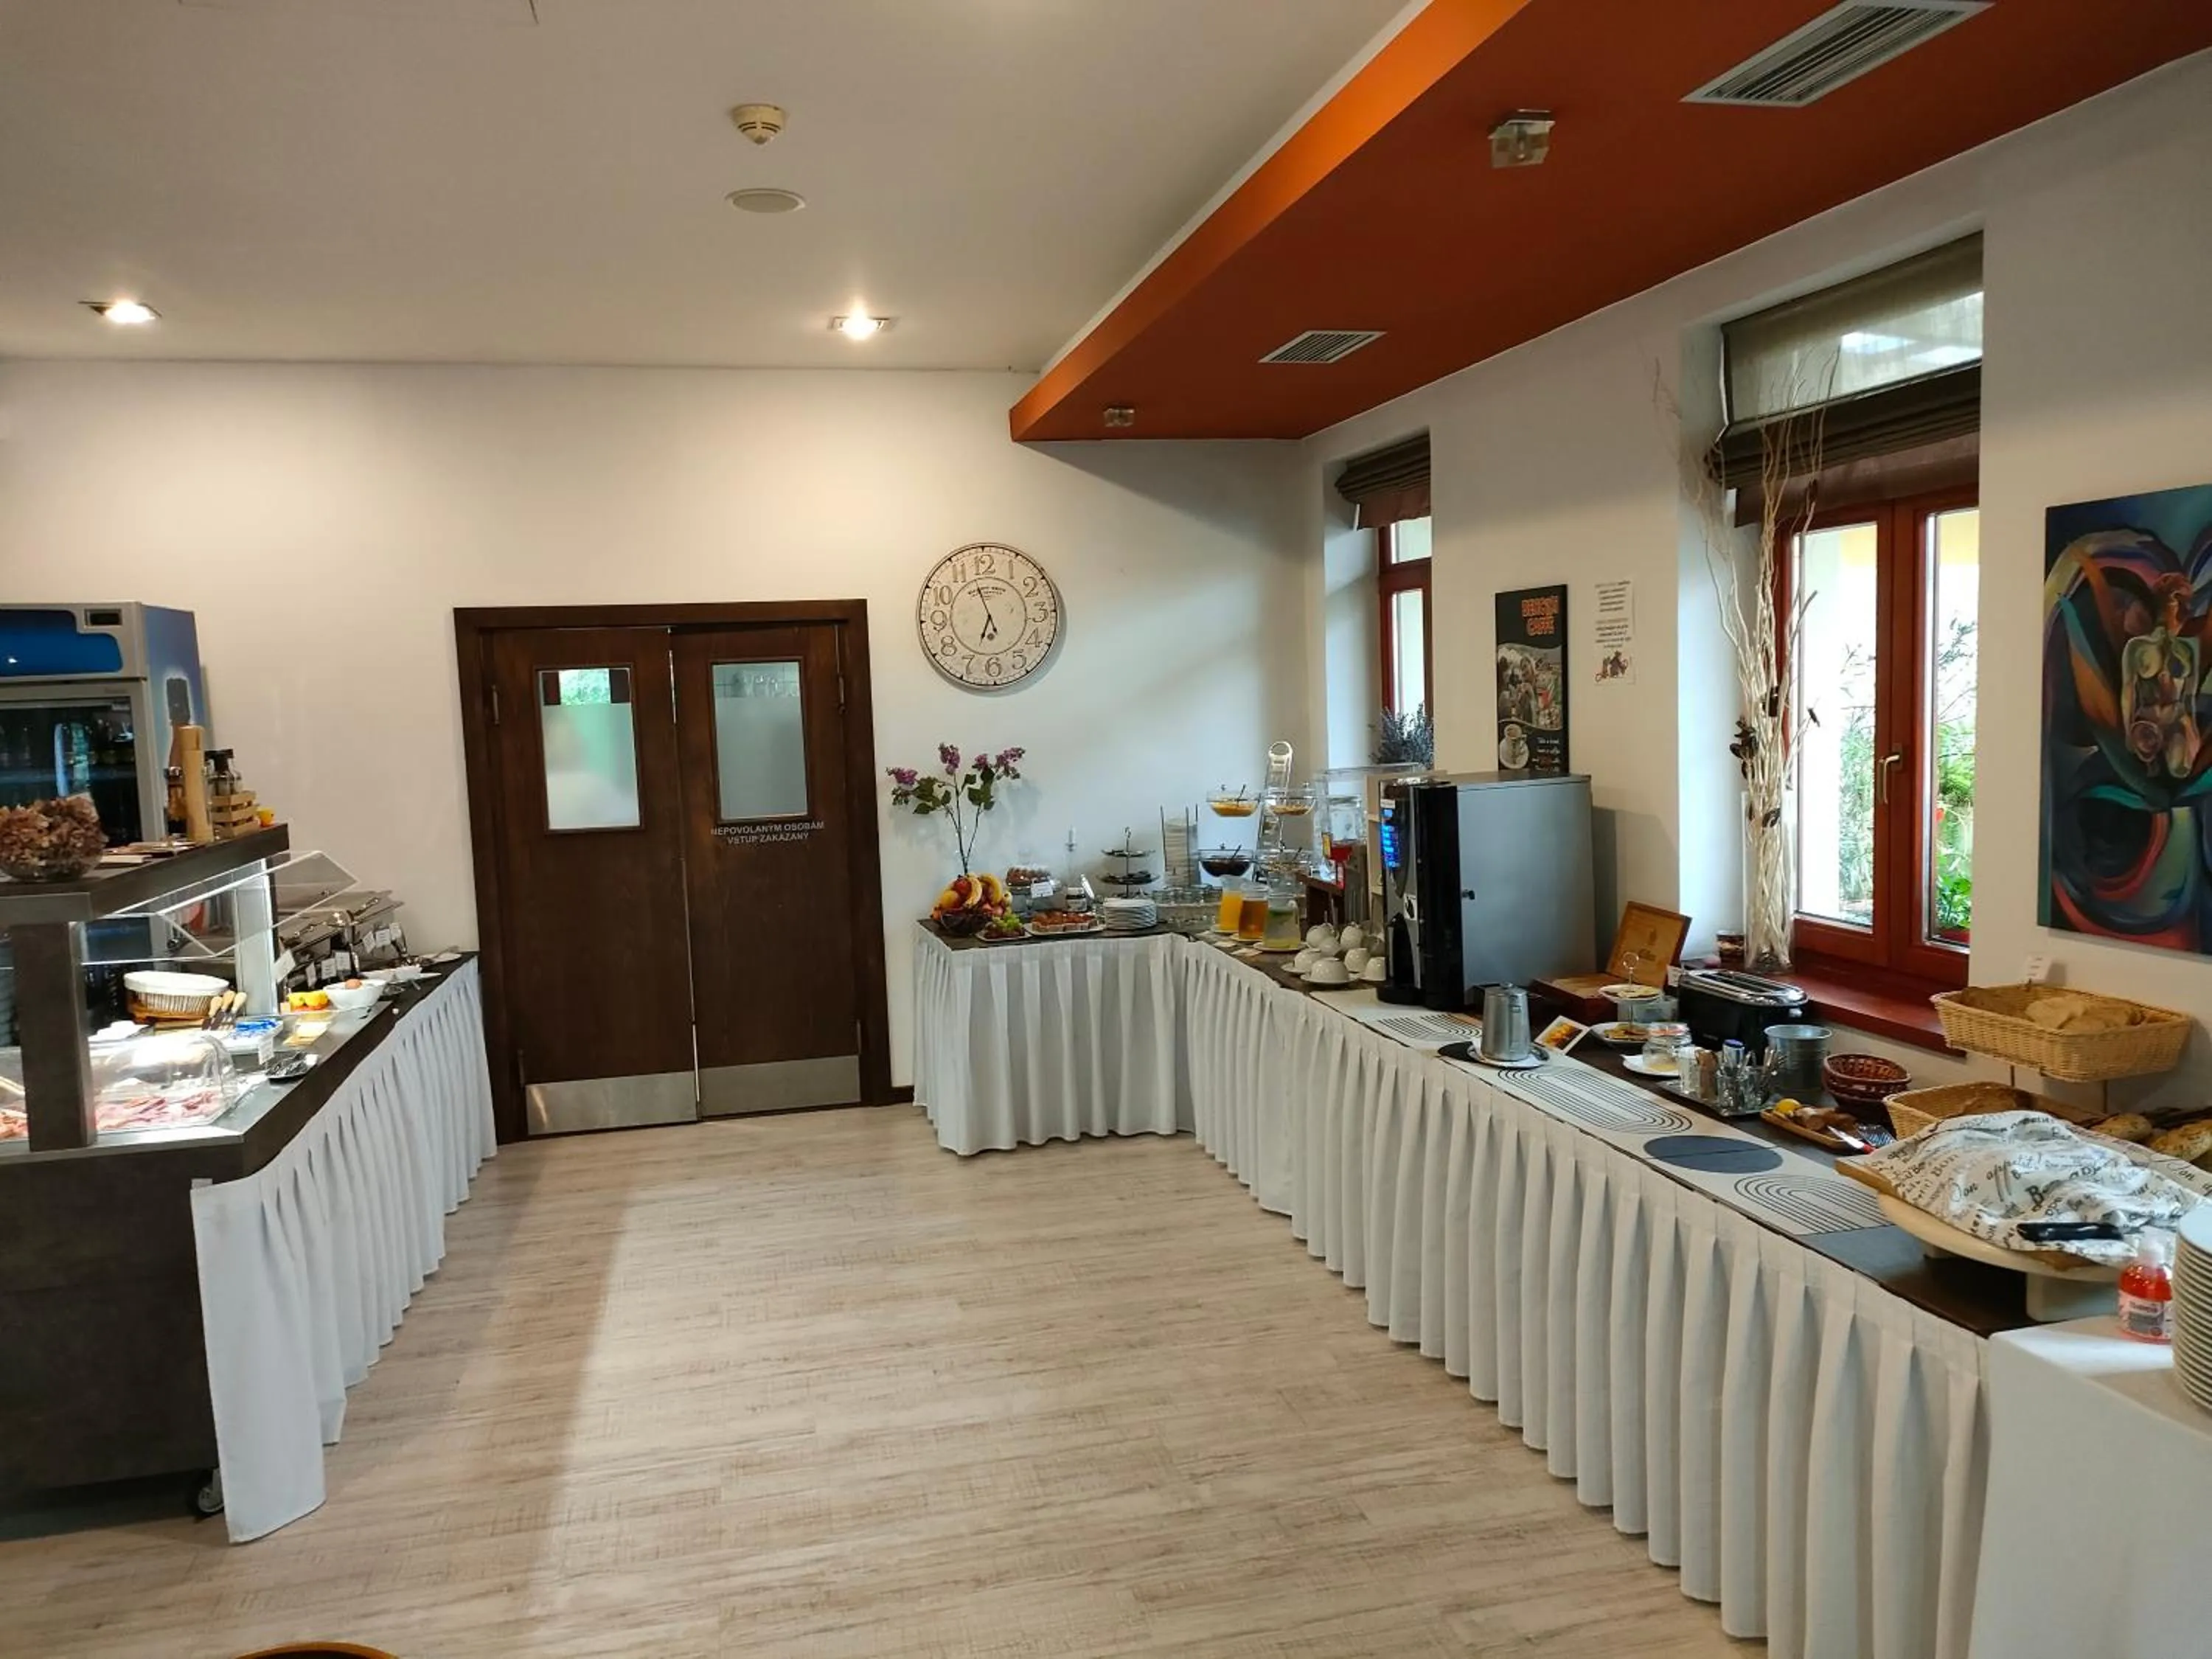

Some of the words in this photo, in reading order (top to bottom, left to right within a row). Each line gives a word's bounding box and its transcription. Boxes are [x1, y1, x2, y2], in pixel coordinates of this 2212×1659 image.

[952, 560, 967, 583] 11
[973, 554, 996, 576] 12
[1007, 559, 1015, 580] 1
[933, 585, 953, 606] 10
[1023, 576, 1039, 598] 2
[930, 610, 948, 632] 9
[1032, 601, 1049, 623] 3
[940, 636, 957, 656] 8
[1025, 627, 1043, 648] 4
[961, 654, 975, 675] 7
[984, 656, 1003, 677] 6
[1011, 649, 1027, 669] 5
